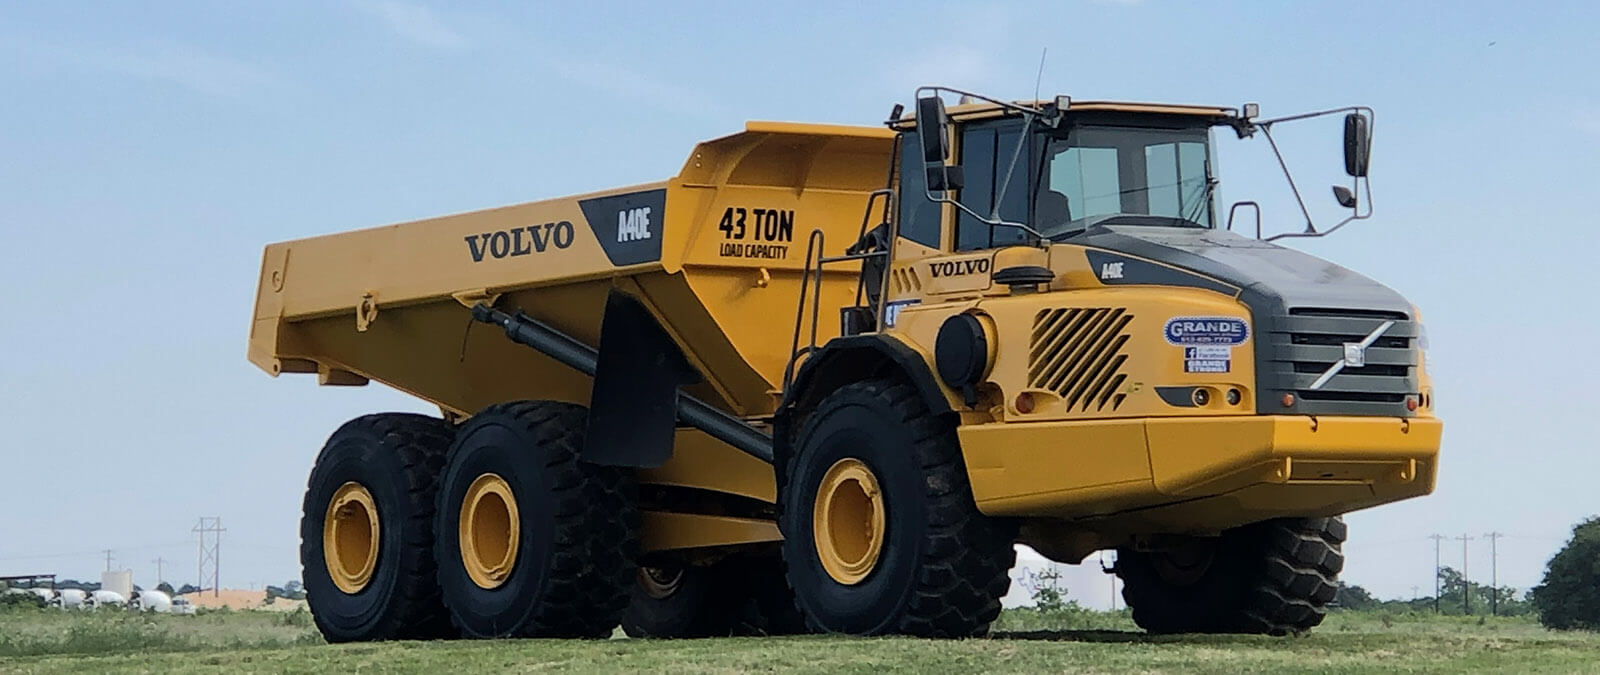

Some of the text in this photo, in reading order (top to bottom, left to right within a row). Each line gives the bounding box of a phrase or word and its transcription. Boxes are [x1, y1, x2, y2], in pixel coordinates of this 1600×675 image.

[616, 207, 652, 243] A40E
[718, 206, 795, 242] 43 TON
[464, 220, 575, 263] VOLVO
[719, 243, 789, 260] LOAD CAPACITY
[929, 258, 990, 278] VOLVO
[1101, 262, 1125, 280] A40E
[1170, 321, 1242, 337] GRANDE
